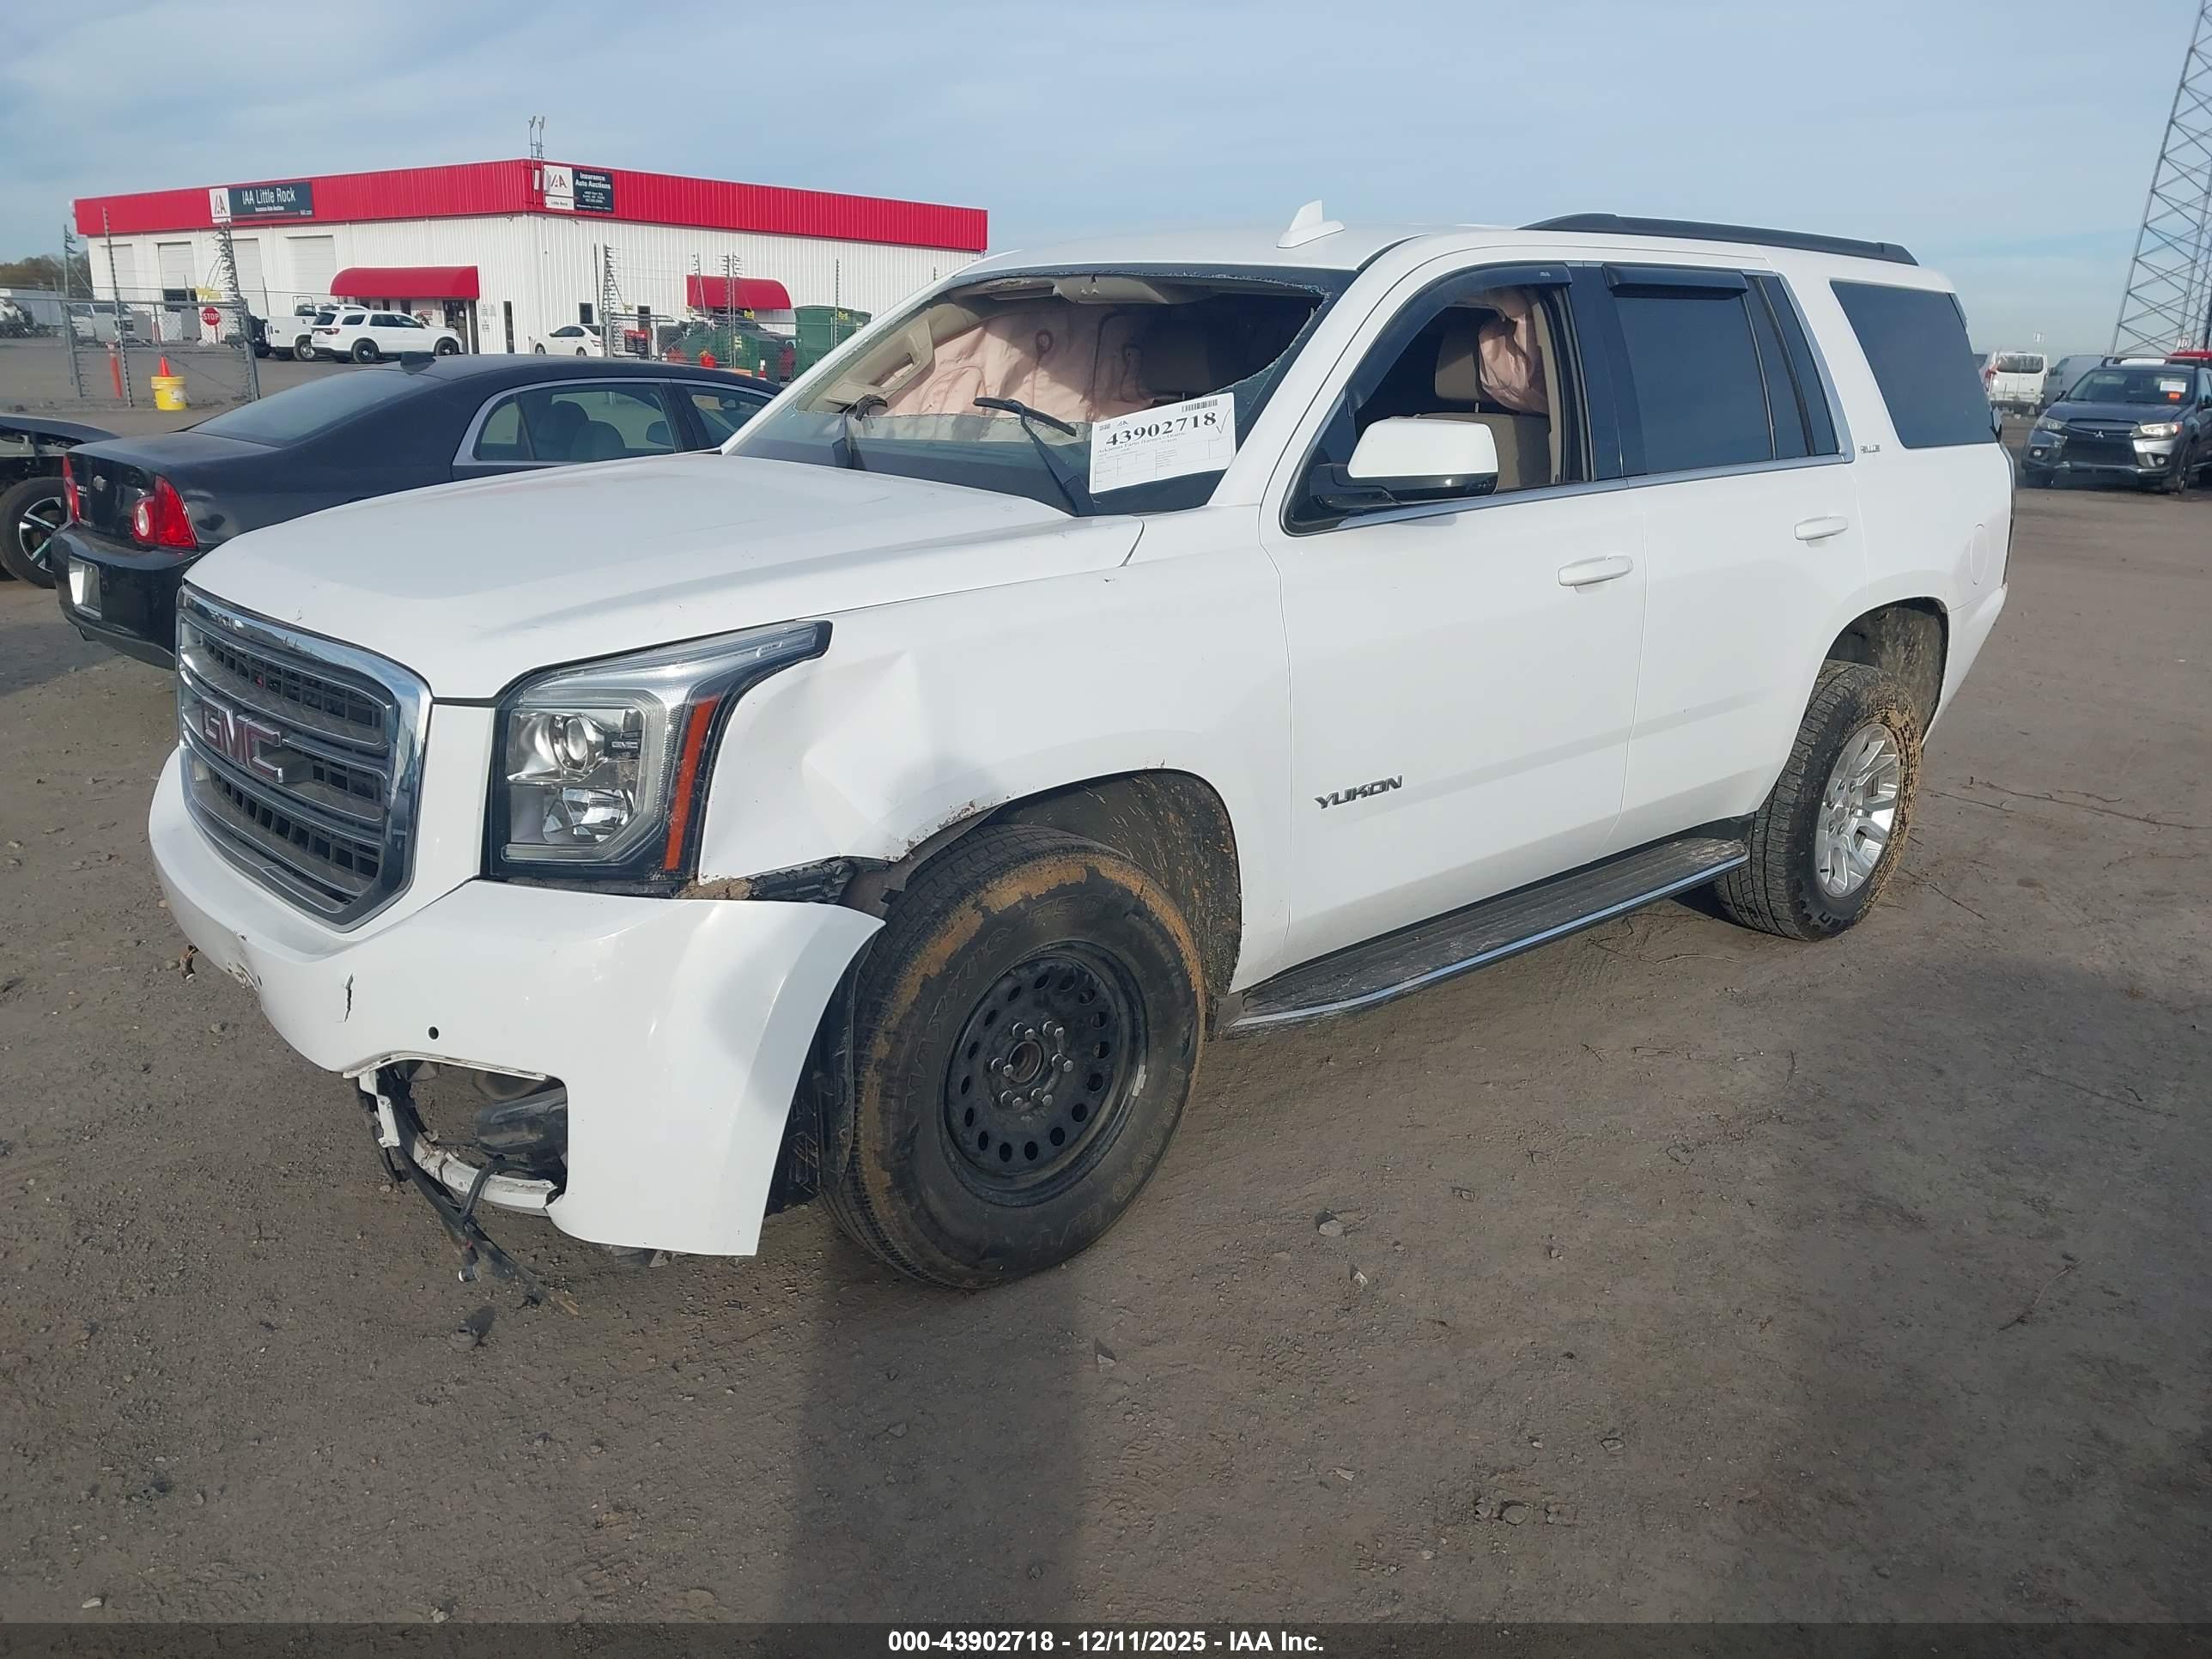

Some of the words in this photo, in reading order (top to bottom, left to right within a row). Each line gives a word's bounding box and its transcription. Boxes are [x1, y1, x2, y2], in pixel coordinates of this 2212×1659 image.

[241, 190, 254, 204] IAA
[255, 188, 274, 204] Little
[276, 186, 296, 203] Rock
[588, 180, 611, 189] Auctions
[202, 313, 219, 321] STOP
[1105, 411, 1217, 446] 43902718
[202, 696, 283, 783] GMC
[1314, 775, 1402, 810] YUKON
